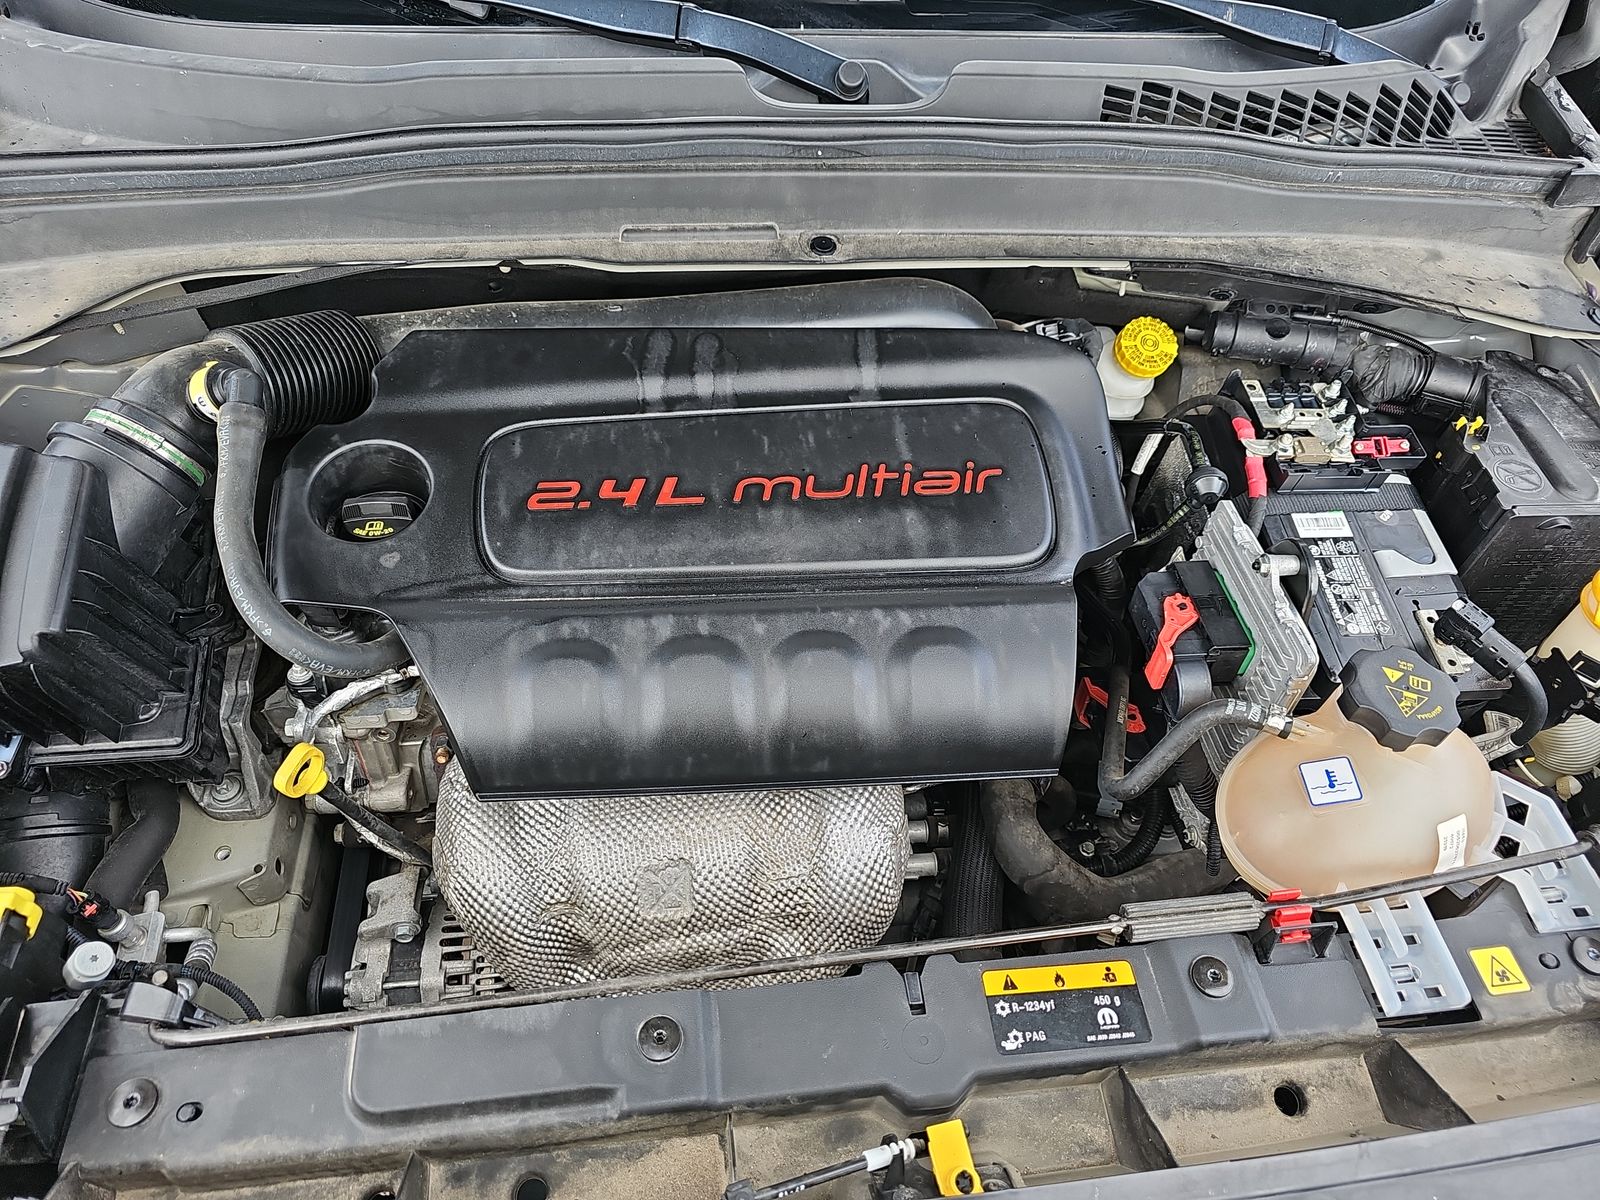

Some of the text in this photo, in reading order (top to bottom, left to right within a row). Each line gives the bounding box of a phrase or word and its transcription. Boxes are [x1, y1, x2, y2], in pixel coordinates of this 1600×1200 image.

[526, 460, 1003, 511] 2.4L multiair
[368, 527, 394, 537] 0W-20
[1012, 999, 1056, 1013] R-1234yf
[1093, 995, 1121, 1007] 450 g
[1025, 1031, 1047, 1042] PAG
